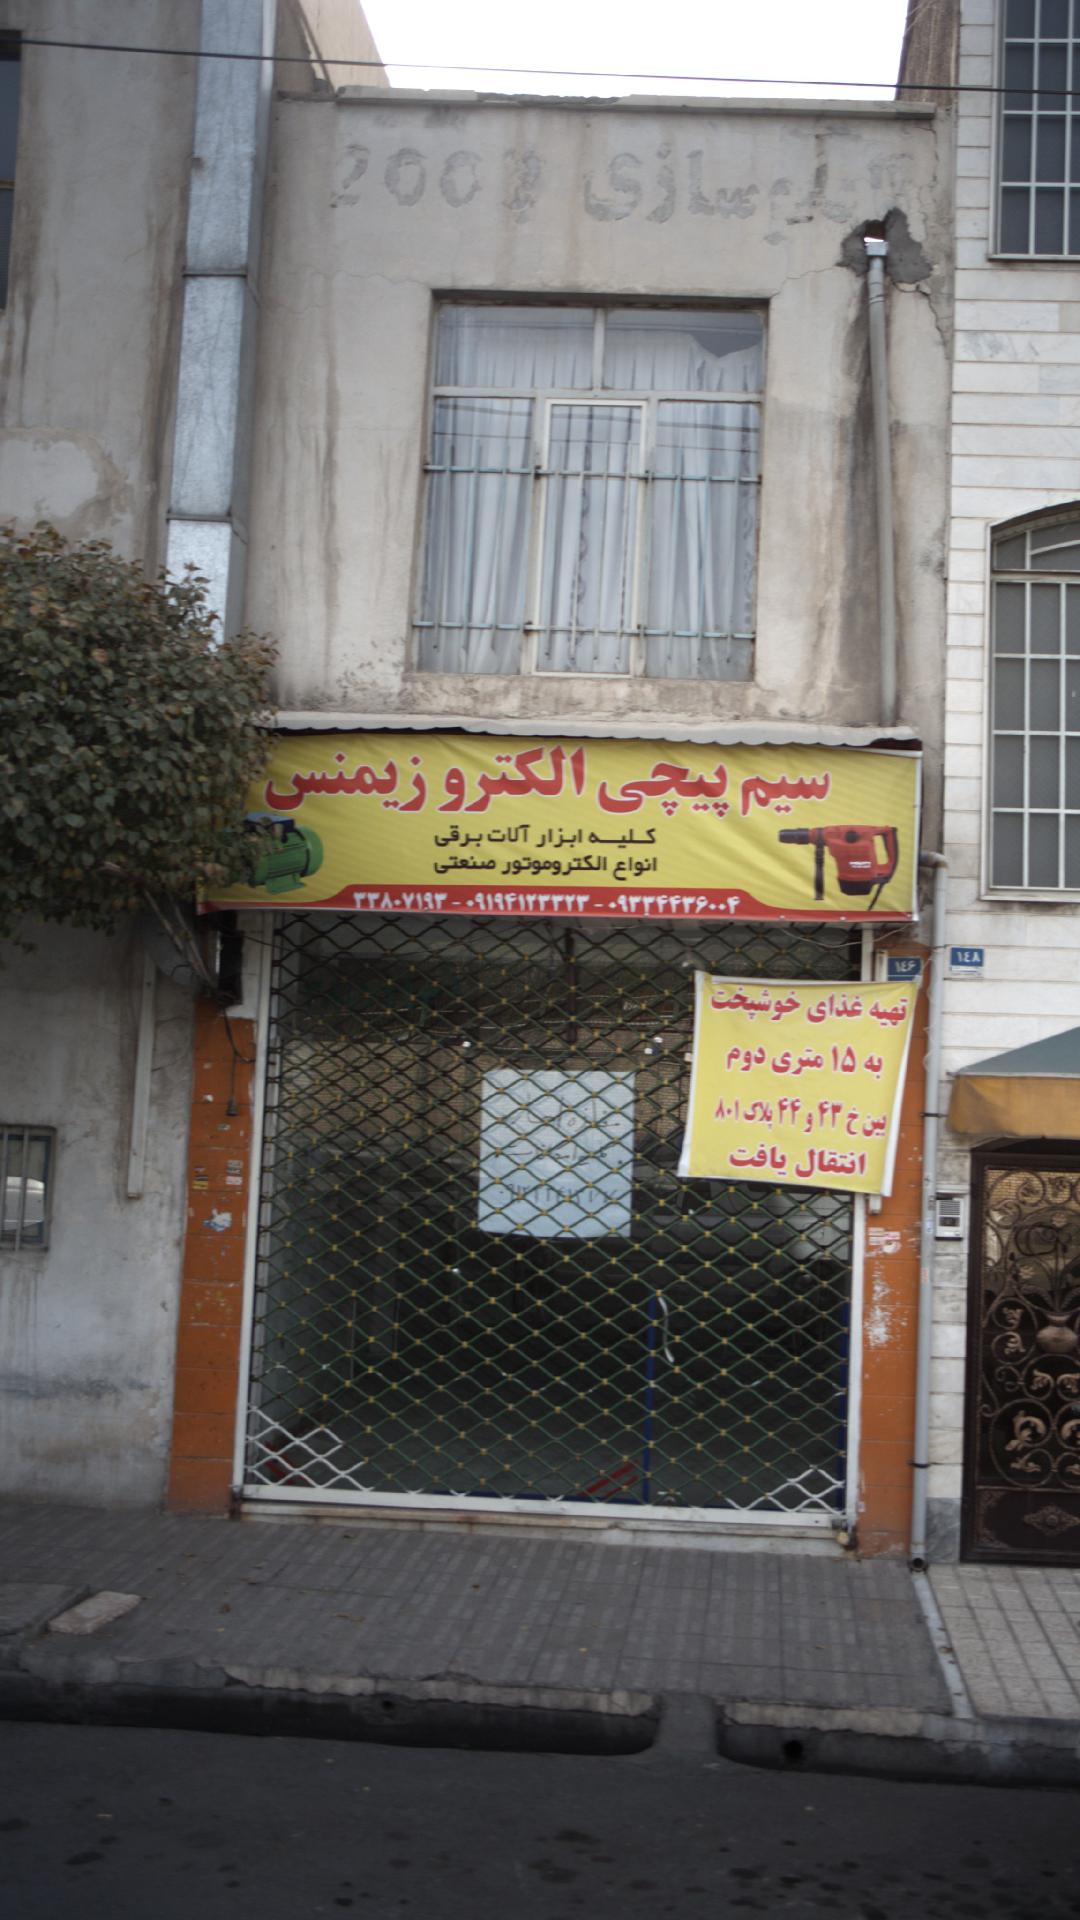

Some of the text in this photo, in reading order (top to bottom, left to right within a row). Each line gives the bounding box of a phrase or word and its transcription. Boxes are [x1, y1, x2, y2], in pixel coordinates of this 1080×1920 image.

[264, 745, 831, 818] سیم پیچی الکترو زیمنس
[434, 824, 656, 849] کلیه ابزار آلات برقی
[434, 855, 658, 881] انواع الکتروموتور صنعتی
[806, 993, 863, 1024] غذای
[869, 997, 908, 1027] تهیه
[726, 1046, 884, 1080] به ۱۵ متری دوم
[743, 1101, 774, 1130] پلاک
[777, 1096, 802, 1126] ۴۴
[803, 1112, 815, 1134] و
[817, 1100, 843, 1129] ۴۳
[845, 1107, 860, 1137] خ
[861, 1114, 888, 1138] بین
[728, 1143, 867, 1179] انتقال یافت
